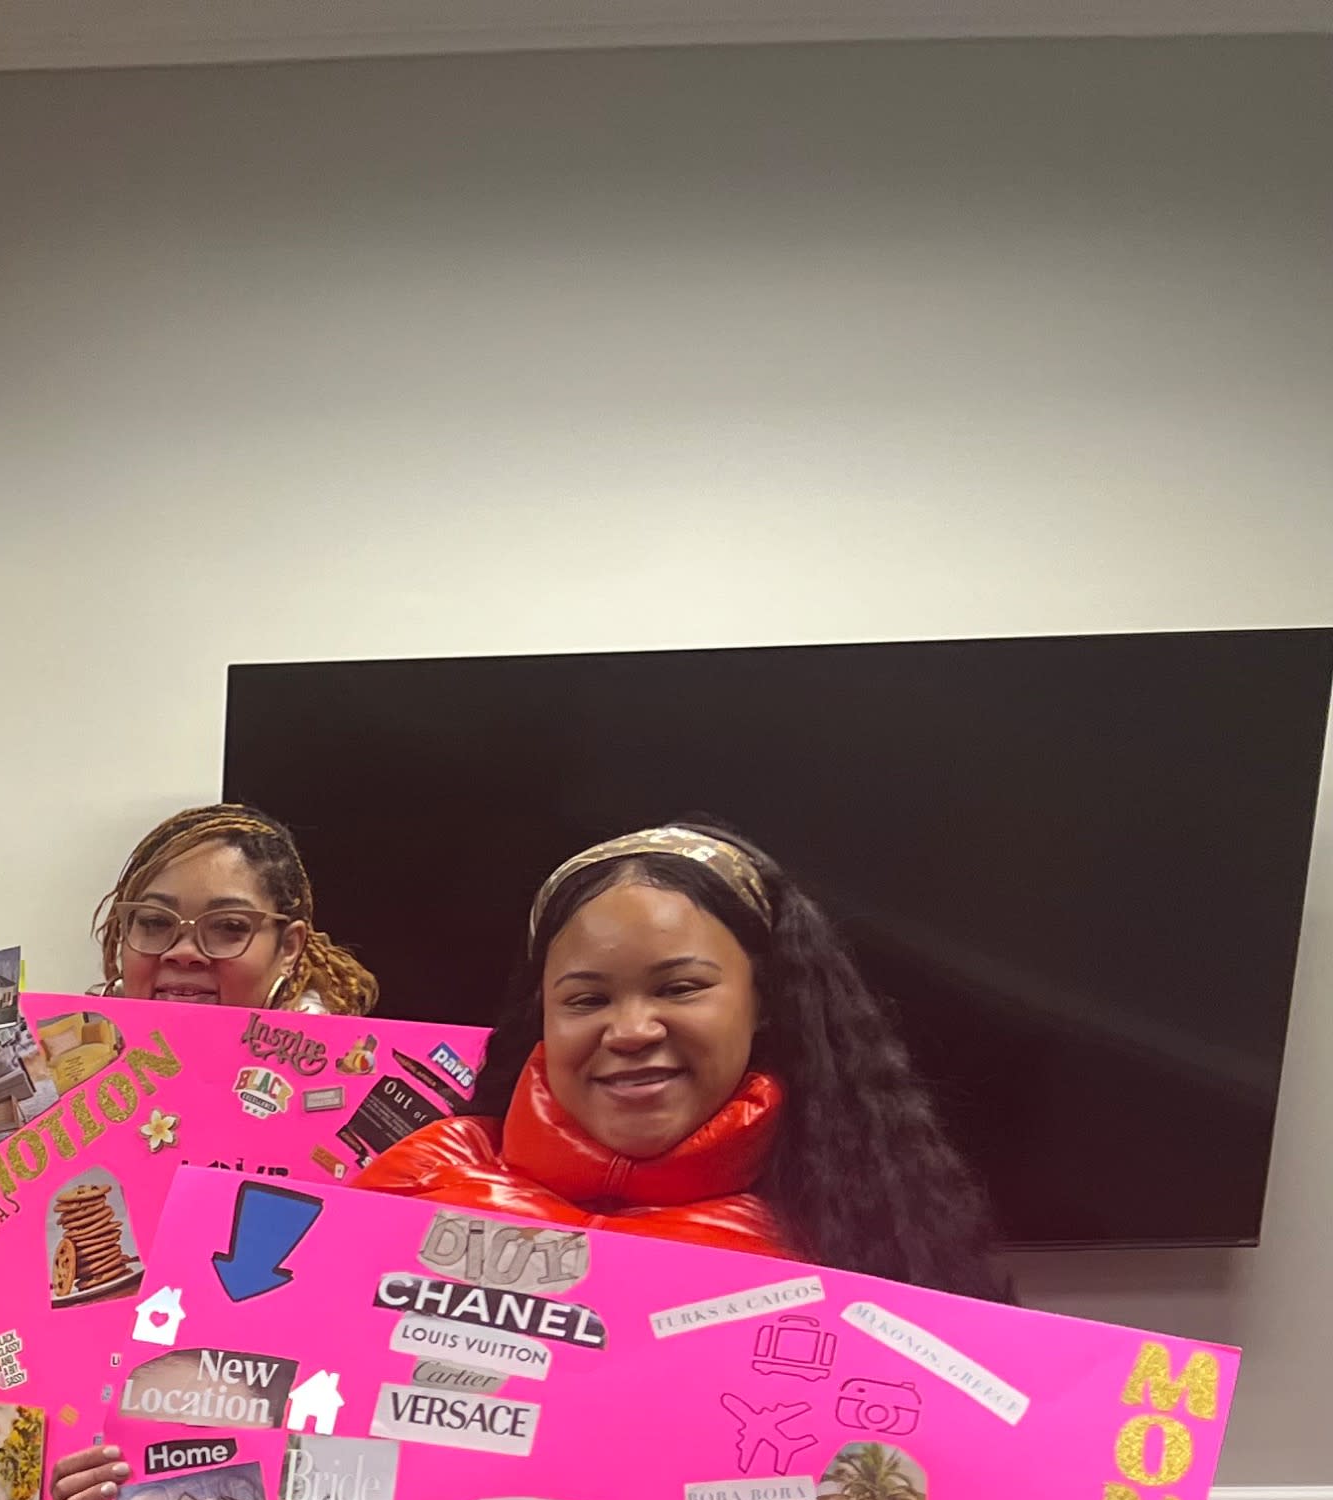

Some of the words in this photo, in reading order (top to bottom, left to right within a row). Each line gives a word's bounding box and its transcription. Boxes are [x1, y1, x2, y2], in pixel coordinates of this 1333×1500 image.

[431, 1047, 474, 1088] paris
[378, 1273, 603, 1344] CHANEL
[652, 1305, 721, 1332] TURKS
[746, 1280, 822, 1310] CAICOS
[401, 1324, 458, 1350] LOUIS
[464, 1337, 549, 1365] VUITTON
[196, 1349, 279, 1388] New
[412, 1359, 499, 1388] Cartier
[121, 1379, 271, 1424] Location
[391, 1391, 531, 1438] VERSACE
[147, 1444, 230, 1470] Home
